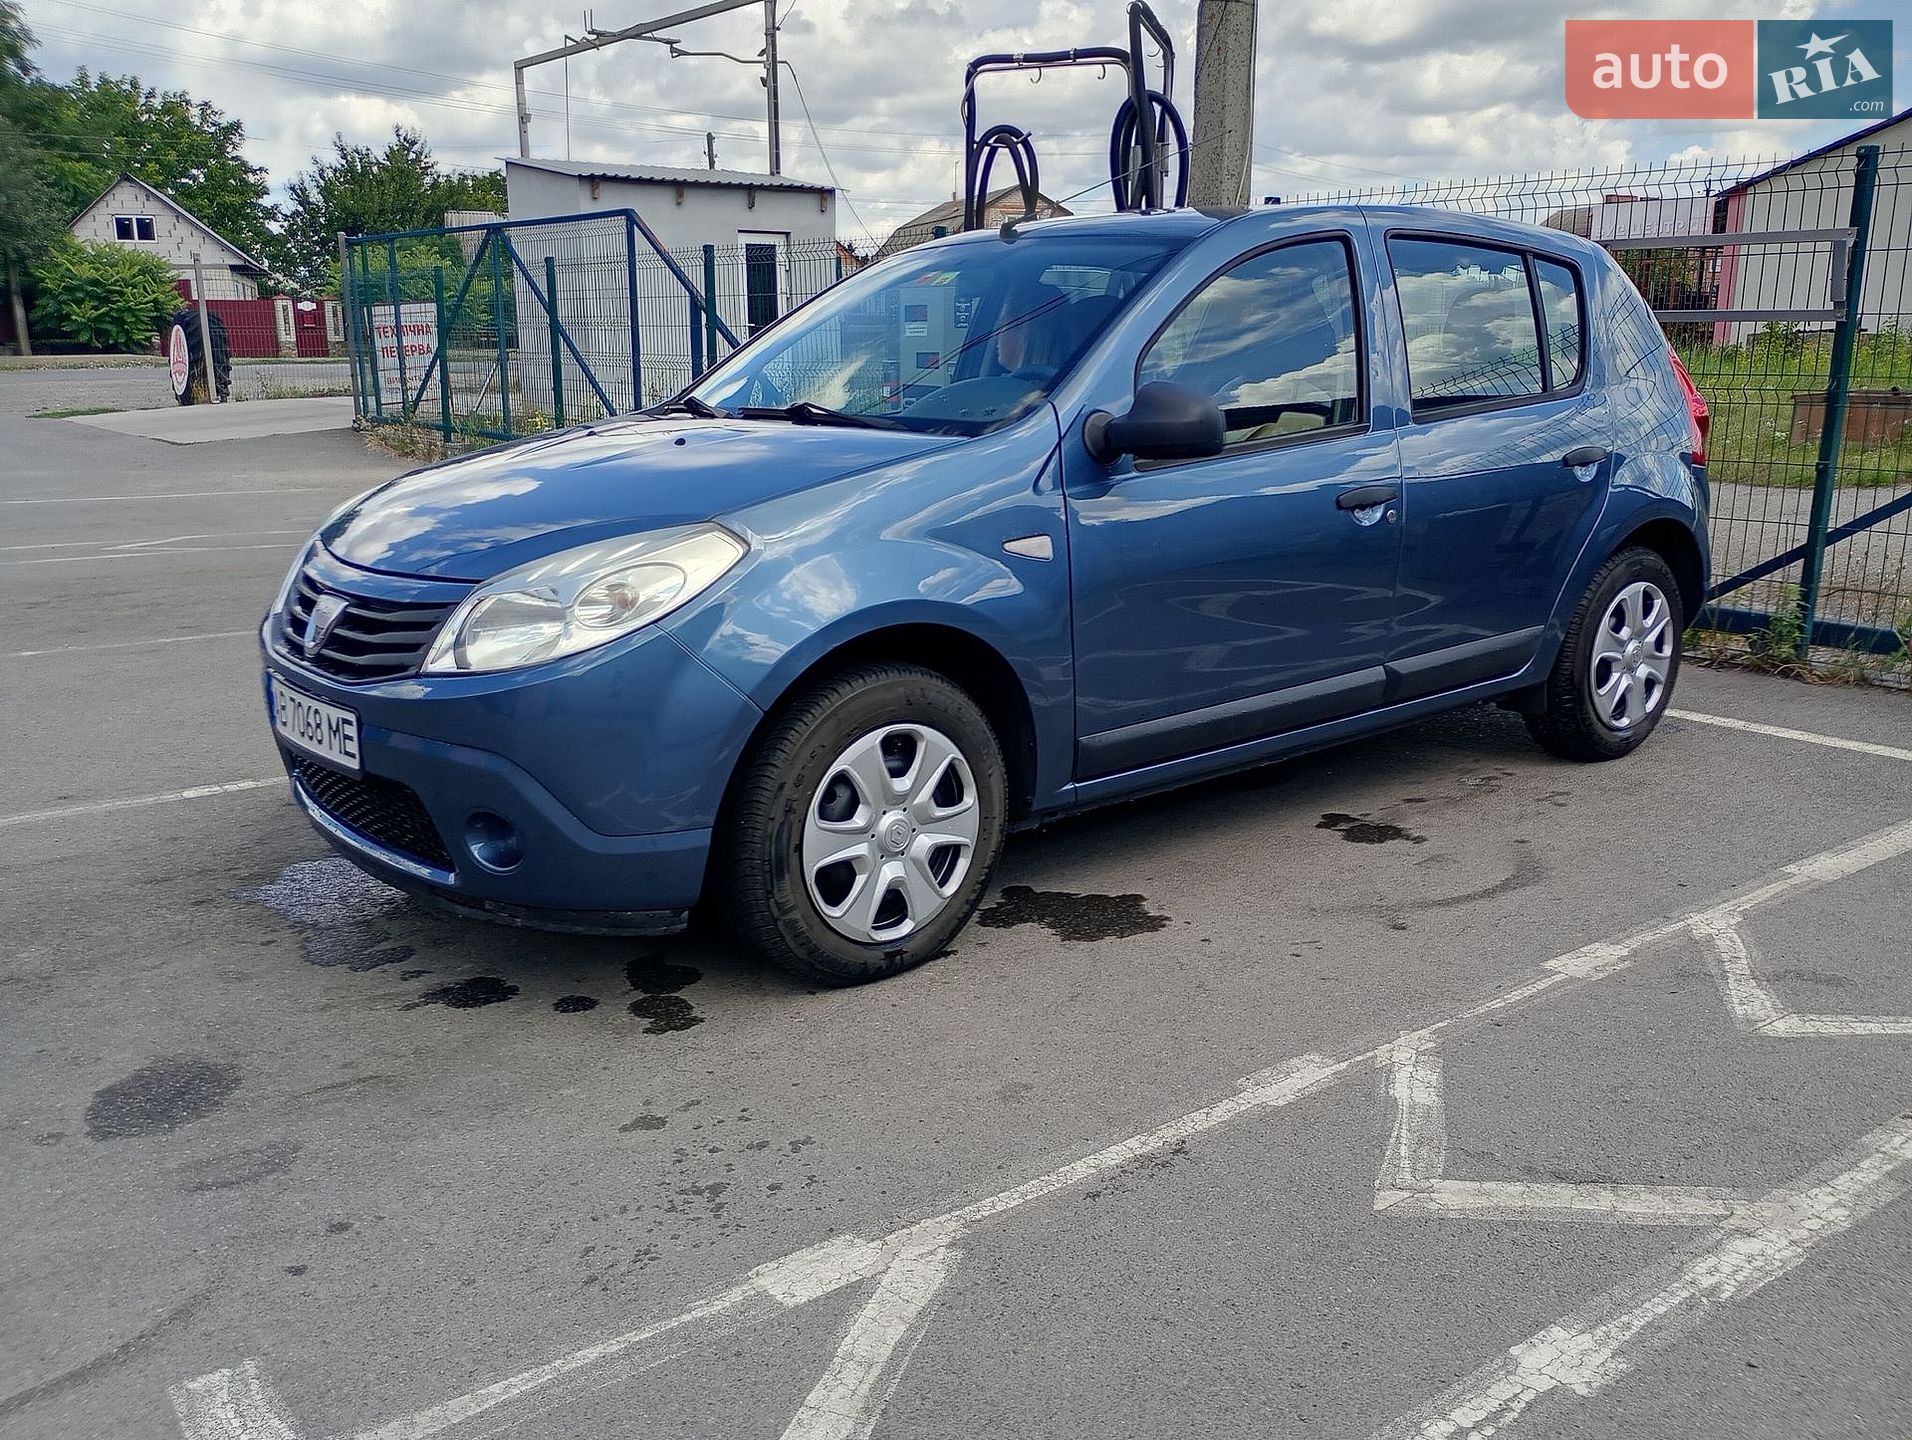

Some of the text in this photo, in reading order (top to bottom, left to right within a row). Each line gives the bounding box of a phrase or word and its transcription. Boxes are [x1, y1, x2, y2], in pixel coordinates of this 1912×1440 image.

[381, 343, 433, 359] ПЕЕРВА
[289, 695, 324, 745] 7068
[327, 712, 357, 760] ME
